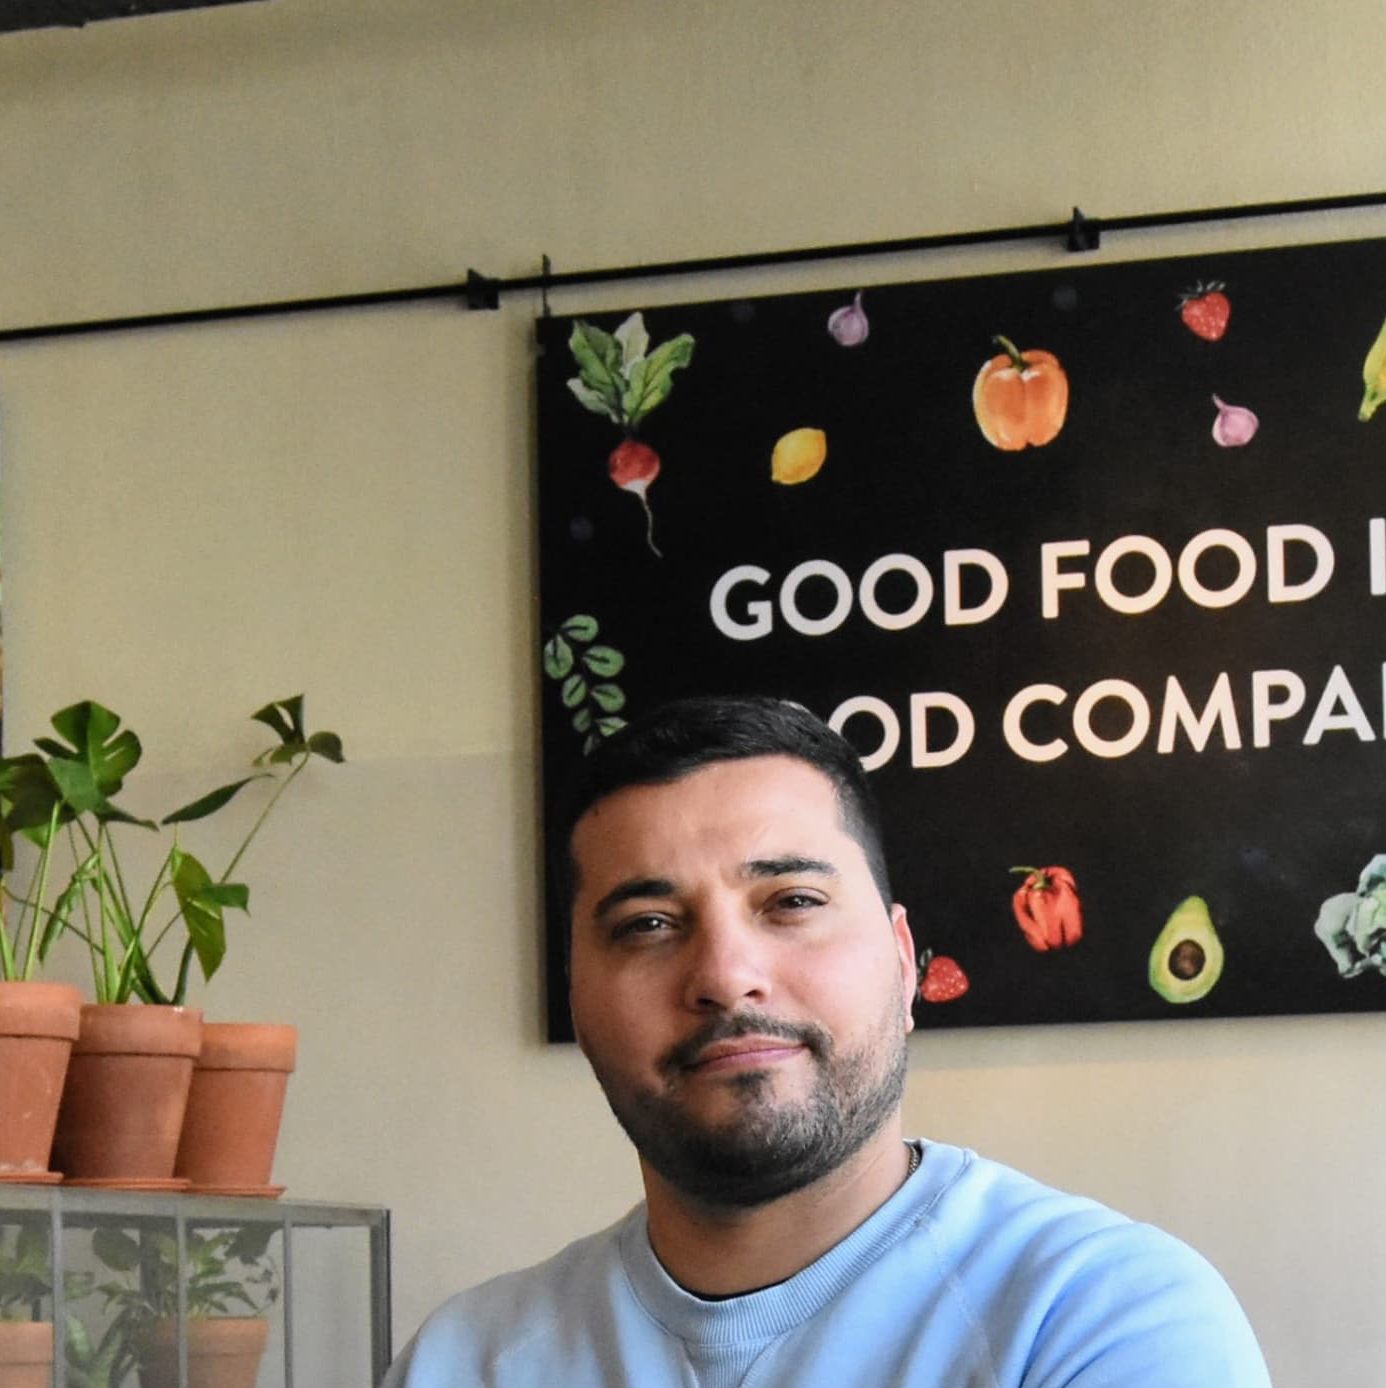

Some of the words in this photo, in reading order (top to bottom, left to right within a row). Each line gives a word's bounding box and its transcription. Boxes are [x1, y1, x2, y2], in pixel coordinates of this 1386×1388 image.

[709, 547, 1010, 642] GOOD
[1041, 522, 1335, 620] FOOD
[825, 691, 976, 781] OD
